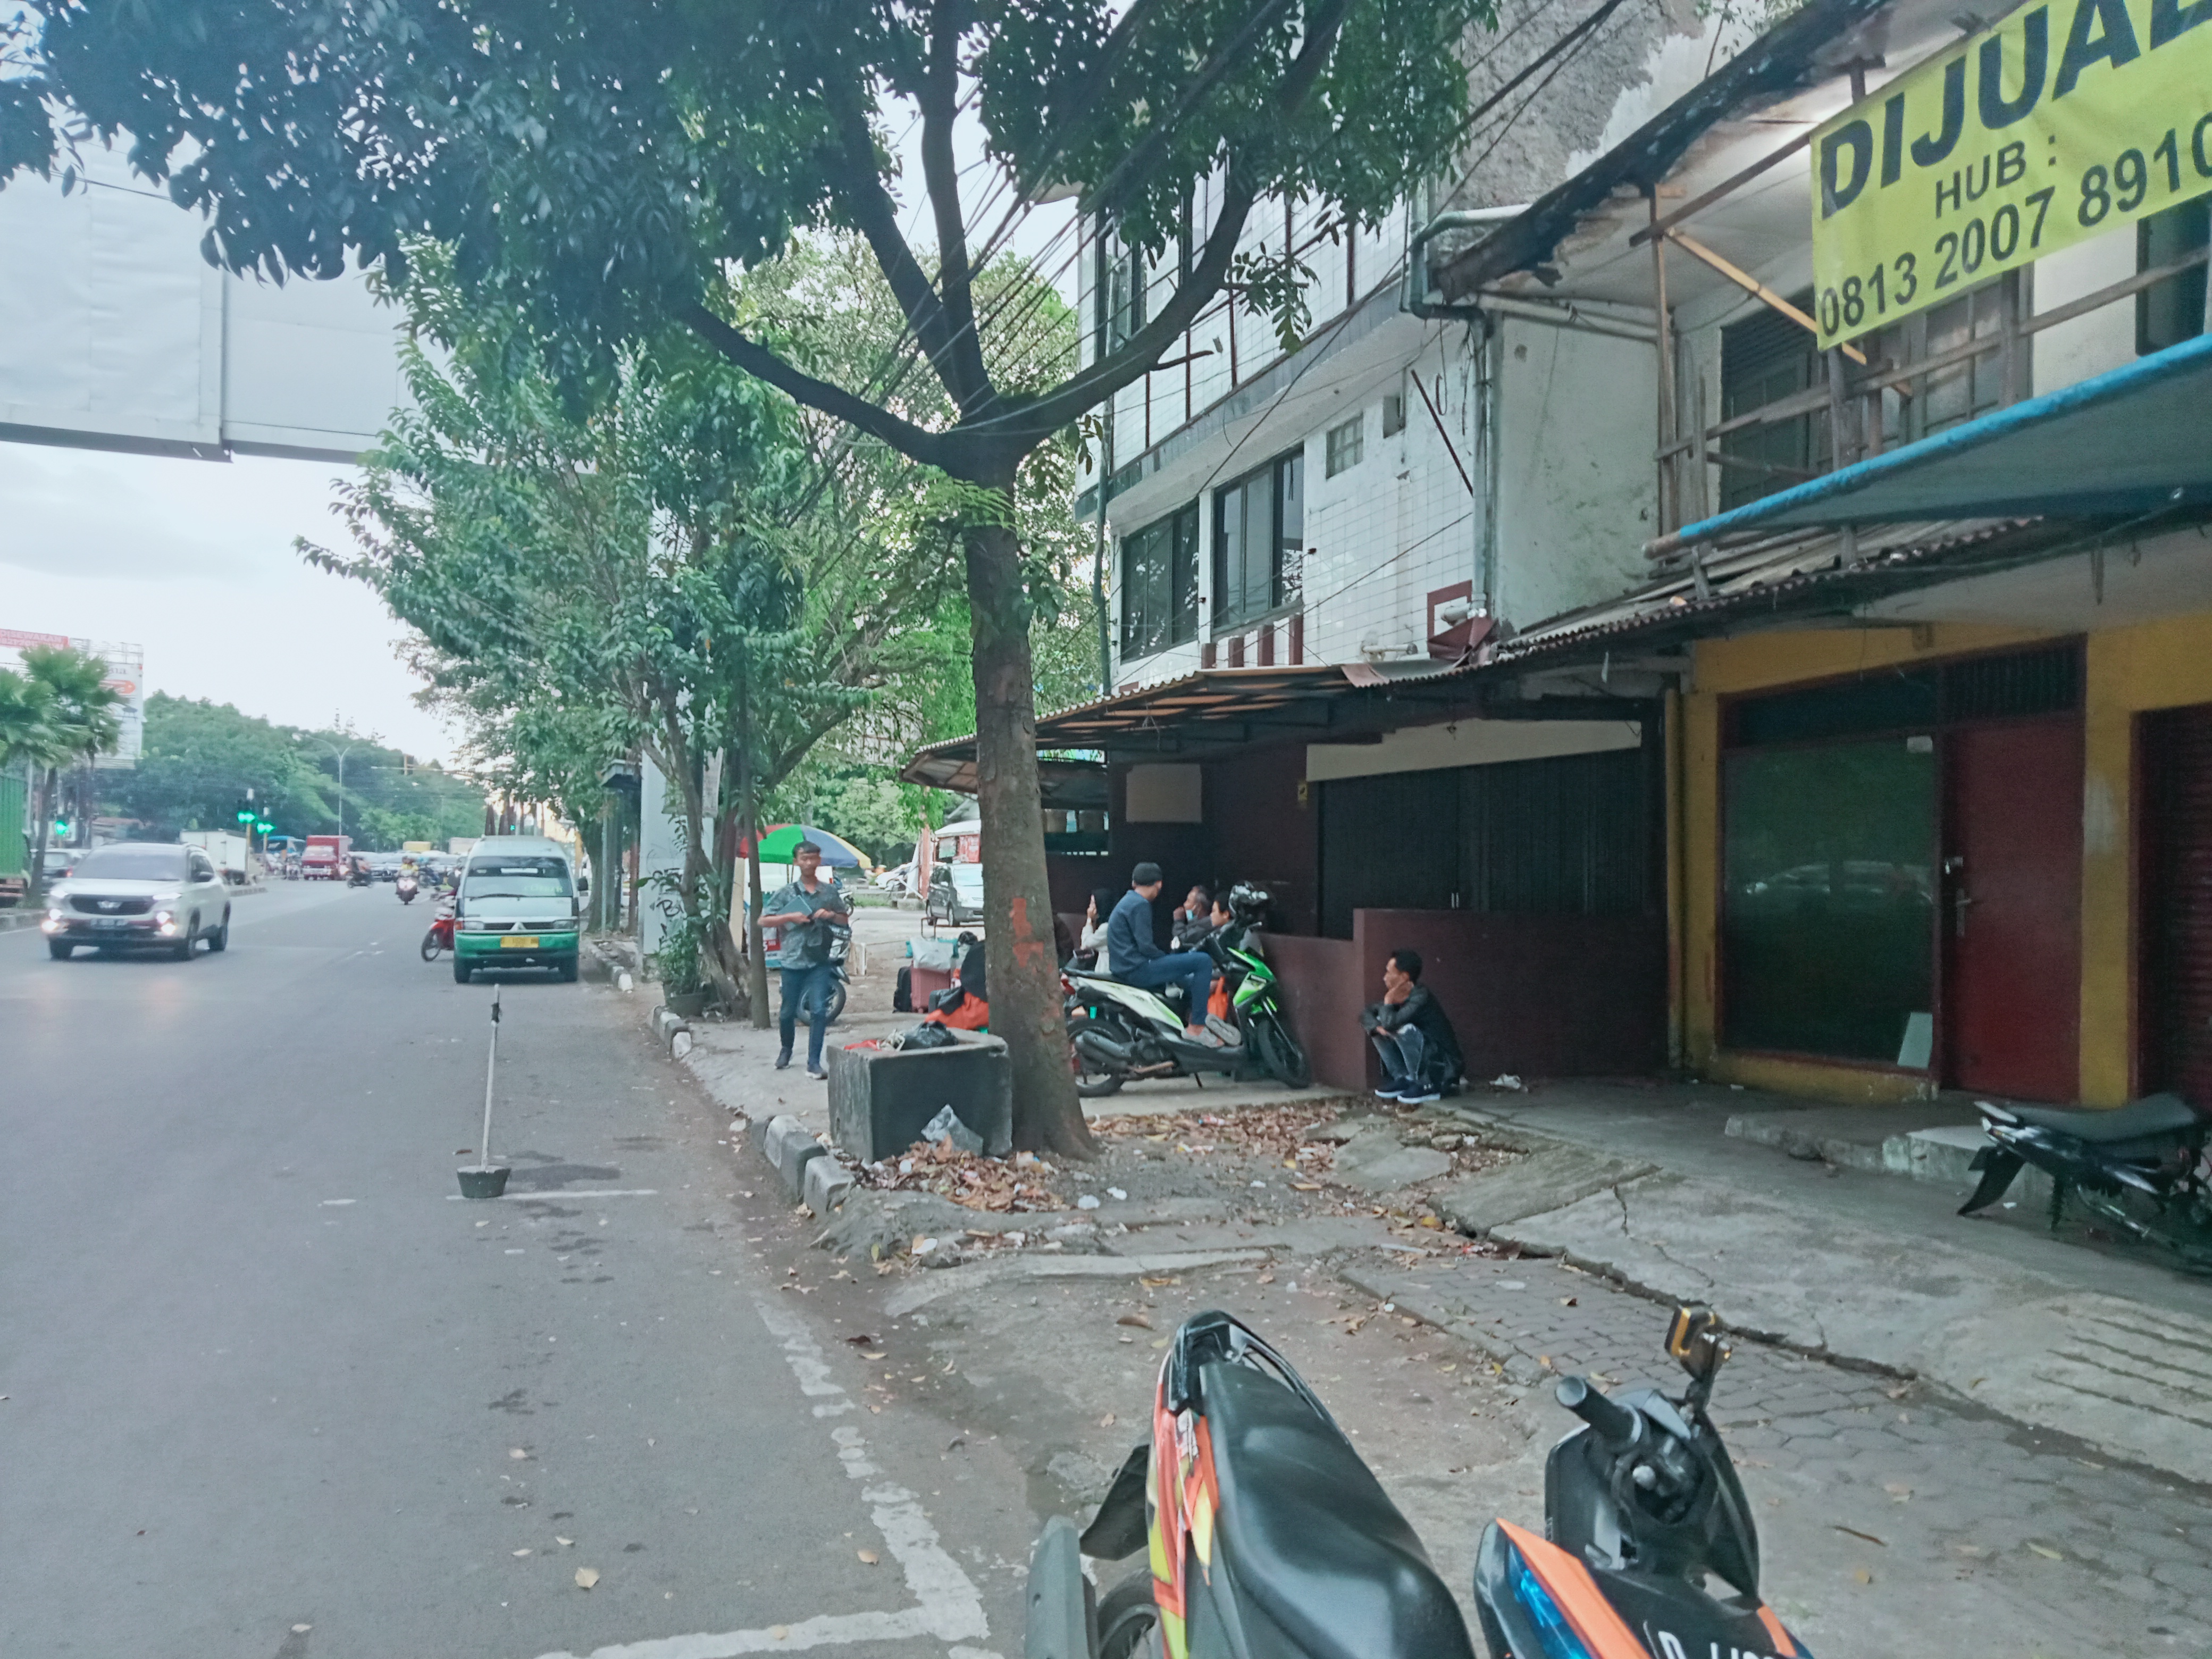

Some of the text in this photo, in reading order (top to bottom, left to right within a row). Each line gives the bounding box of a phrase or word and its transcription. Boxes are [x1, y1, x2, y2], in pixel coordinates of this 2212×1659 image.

[1936, 140, 2026, 219] HUB
[1821, 252, 1917, 337] 0813
[1934, 186, 2056, 290] 2007
